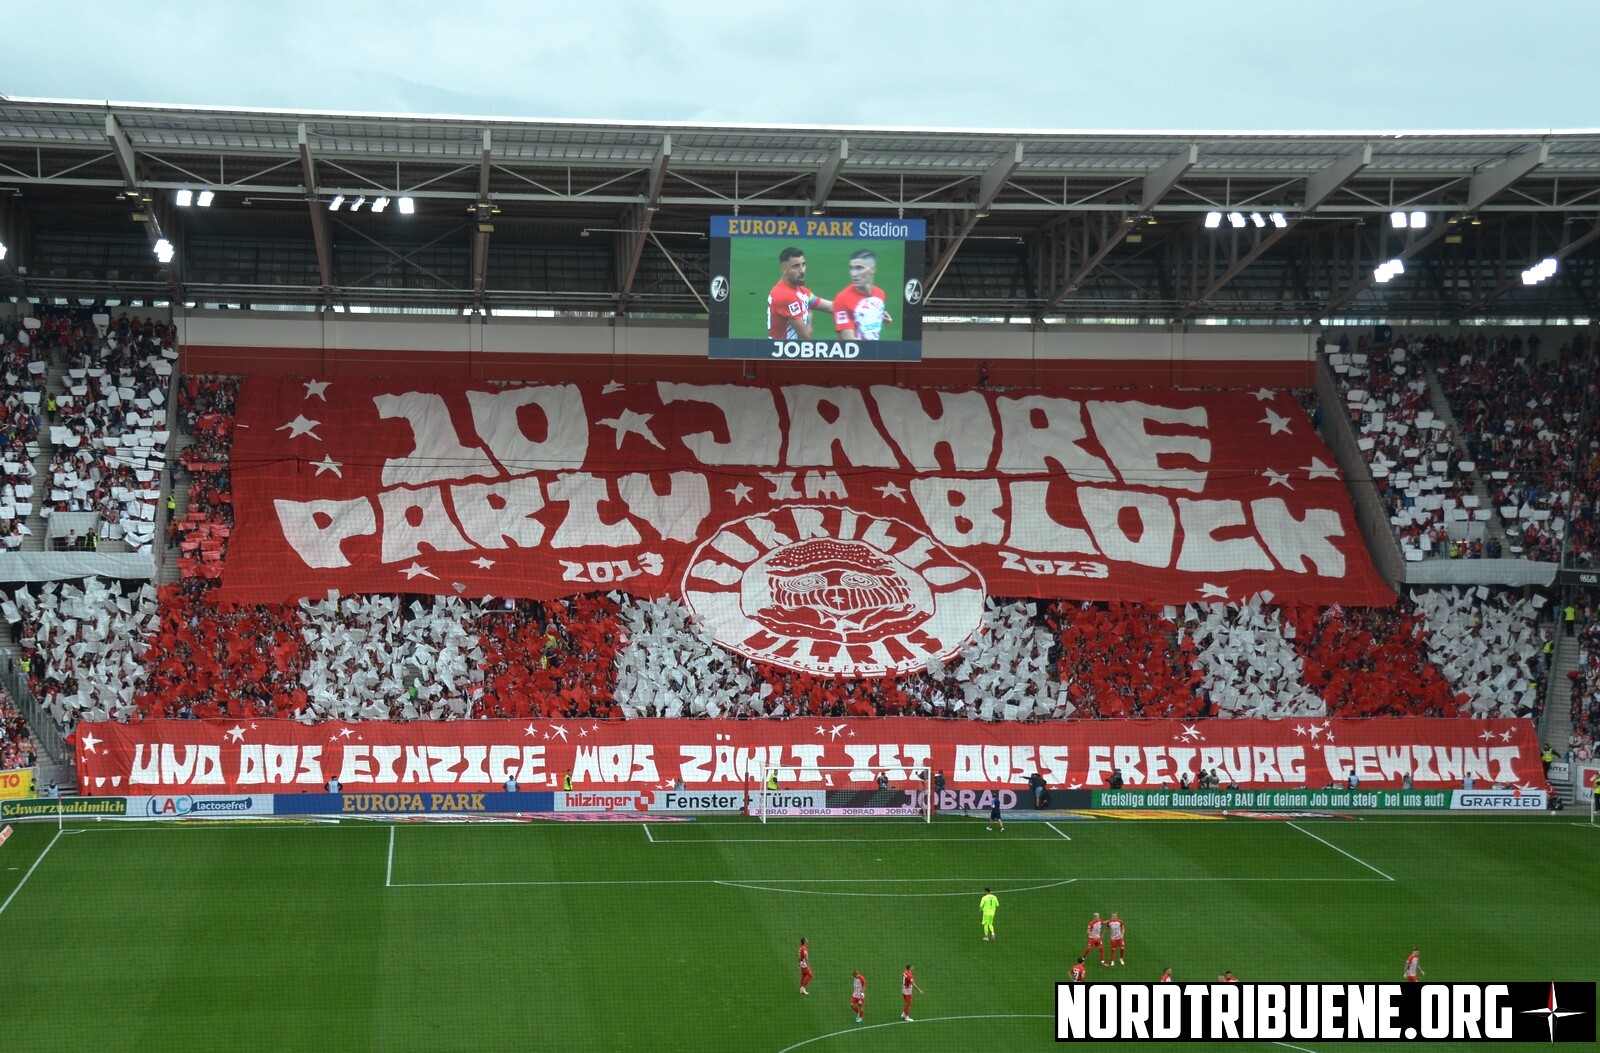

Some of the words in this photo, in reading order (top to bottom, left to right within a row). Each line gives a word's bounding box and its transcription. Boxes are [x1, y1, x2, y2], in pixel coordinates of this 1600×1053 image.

[728, 219, 800, 236] EUROPA
[807, 220, 853, 237] PARK
[859, 221, 908, 237] Stadion
[771, 341, 860, 359] JOBRAD
[373, 383, 589, 487] 10
[657, 381, 1212, 493] JAHRE
[274, 470, 711, 568] PARTY
[761, 470, 849, 500] IM
[910, 476, 1346, 578] BLOCK
[558, 551, 664, 583] 2013
[998, 550, 1109, 579] 2023
[236, 744, 323, 785] DAS
[573, 745, 659, 783] WAS
[844, 744, 932, 783] IST
[953, 744, 1068, 786] DASS
[1086, 745, 1306, 786] FREIBURG
[1323, 745, 1520, 783] GEWINNT
[2, 801, 125, 815] Schwarzwaldmilch
[152, 797, 189, 814] LAC
[197, 802, 248, 810] lactosefrei
[342, 794, 425, 812] EUROPA
[432, 794, 485, 811] PARK
[565, 793, 631, 811] hilzinger
[665, 793, 736, 808] Fenster
[761, 793, 813, 808] Türen
[902, 790, 1017, 809] JOBRAD
[1101, 792, 1144, 807] Kreisliga
[1147, 793, 1169, 806] oder
[1172, 793, 1232, 807] Bundesliga?
[1235, 793, 1253, 806] BAU
[1257, 793, 1270, 806] dir
[1274, 793, 1305, 806] deinen
[1310, 793, 1328, 806] Job
[1331, 793, 1350, 806] und
[1385, 793, 1400, 806] bei
[1403, 794, 1421, 806] uns
[1424, 793, 1444, 806] auf!
[1460, 794, 1541, 807] GRAFRIED
